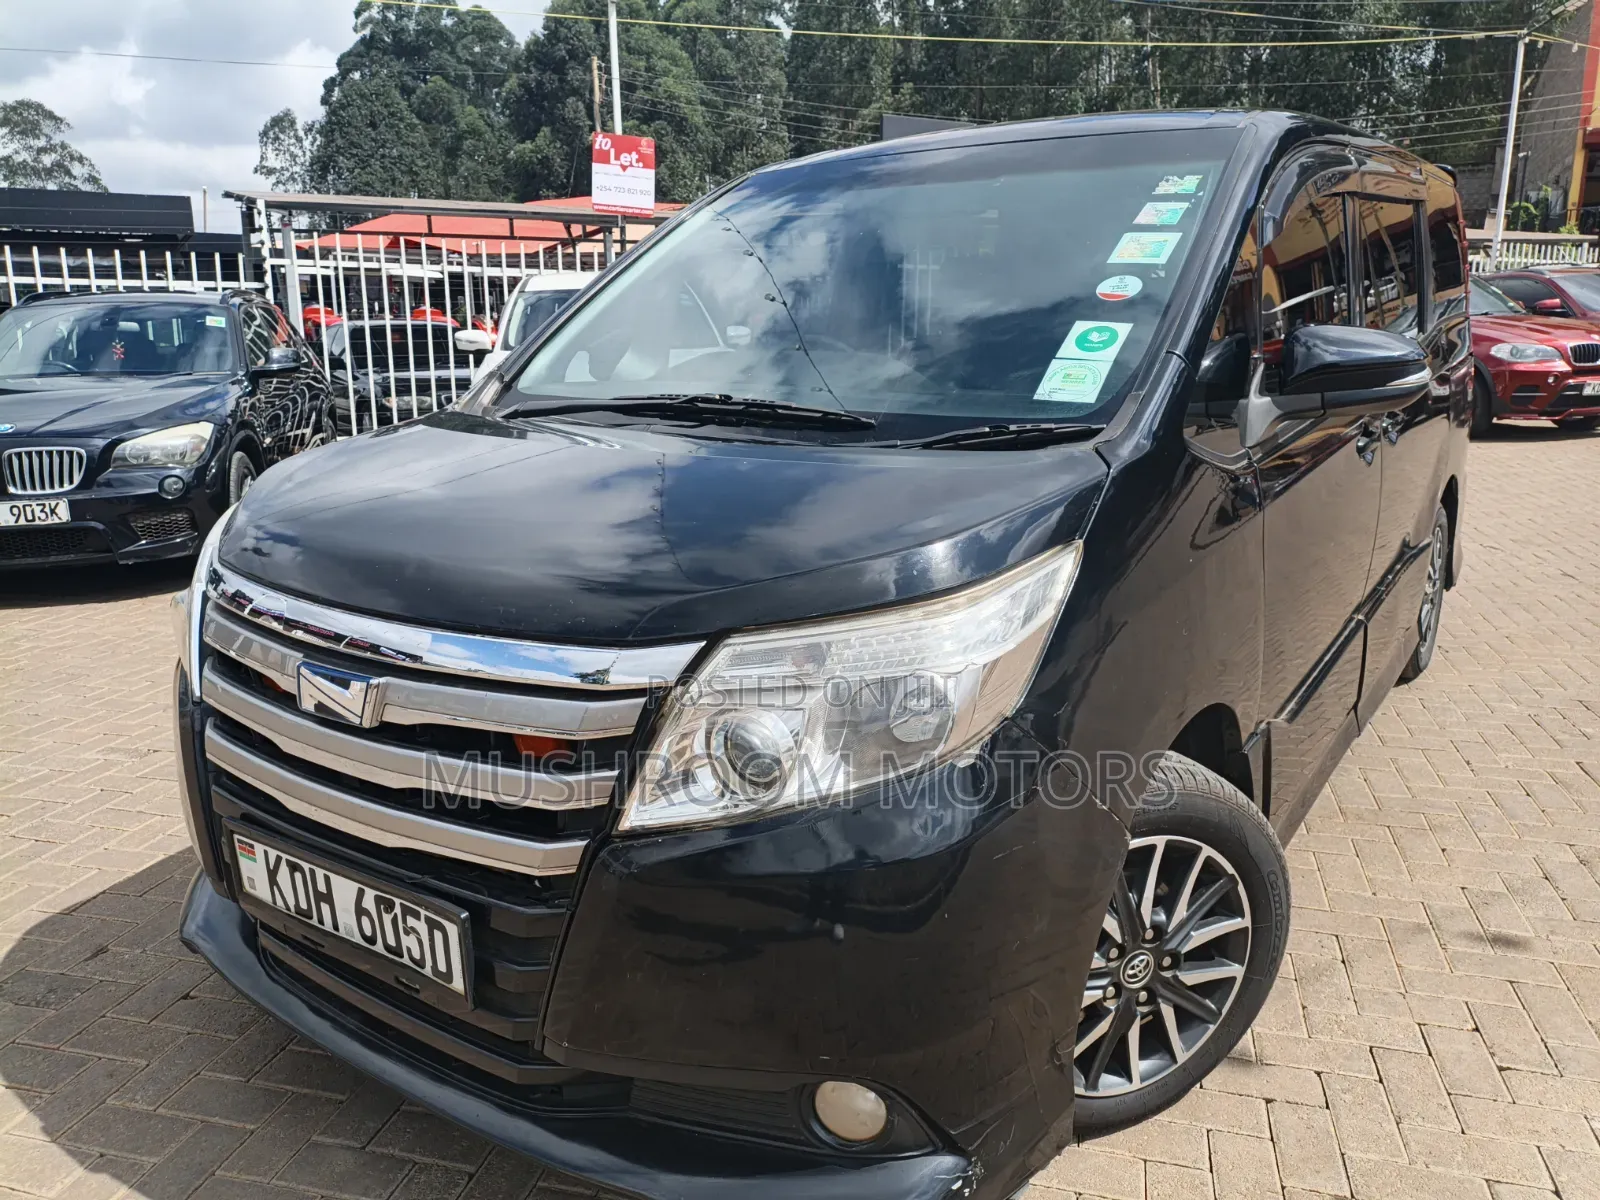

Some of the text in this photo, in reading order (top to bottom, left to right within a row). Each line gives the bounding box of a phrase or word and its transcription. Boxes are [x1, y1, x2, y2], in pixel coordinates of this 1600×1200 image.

[594, 134, 612, 150] to
[609, 148, 644, 168] Let.
[9, 502, 63, 524] 903K
[263, 848, 340, 932] KDH
[354, 886, 453, 985] 605D
